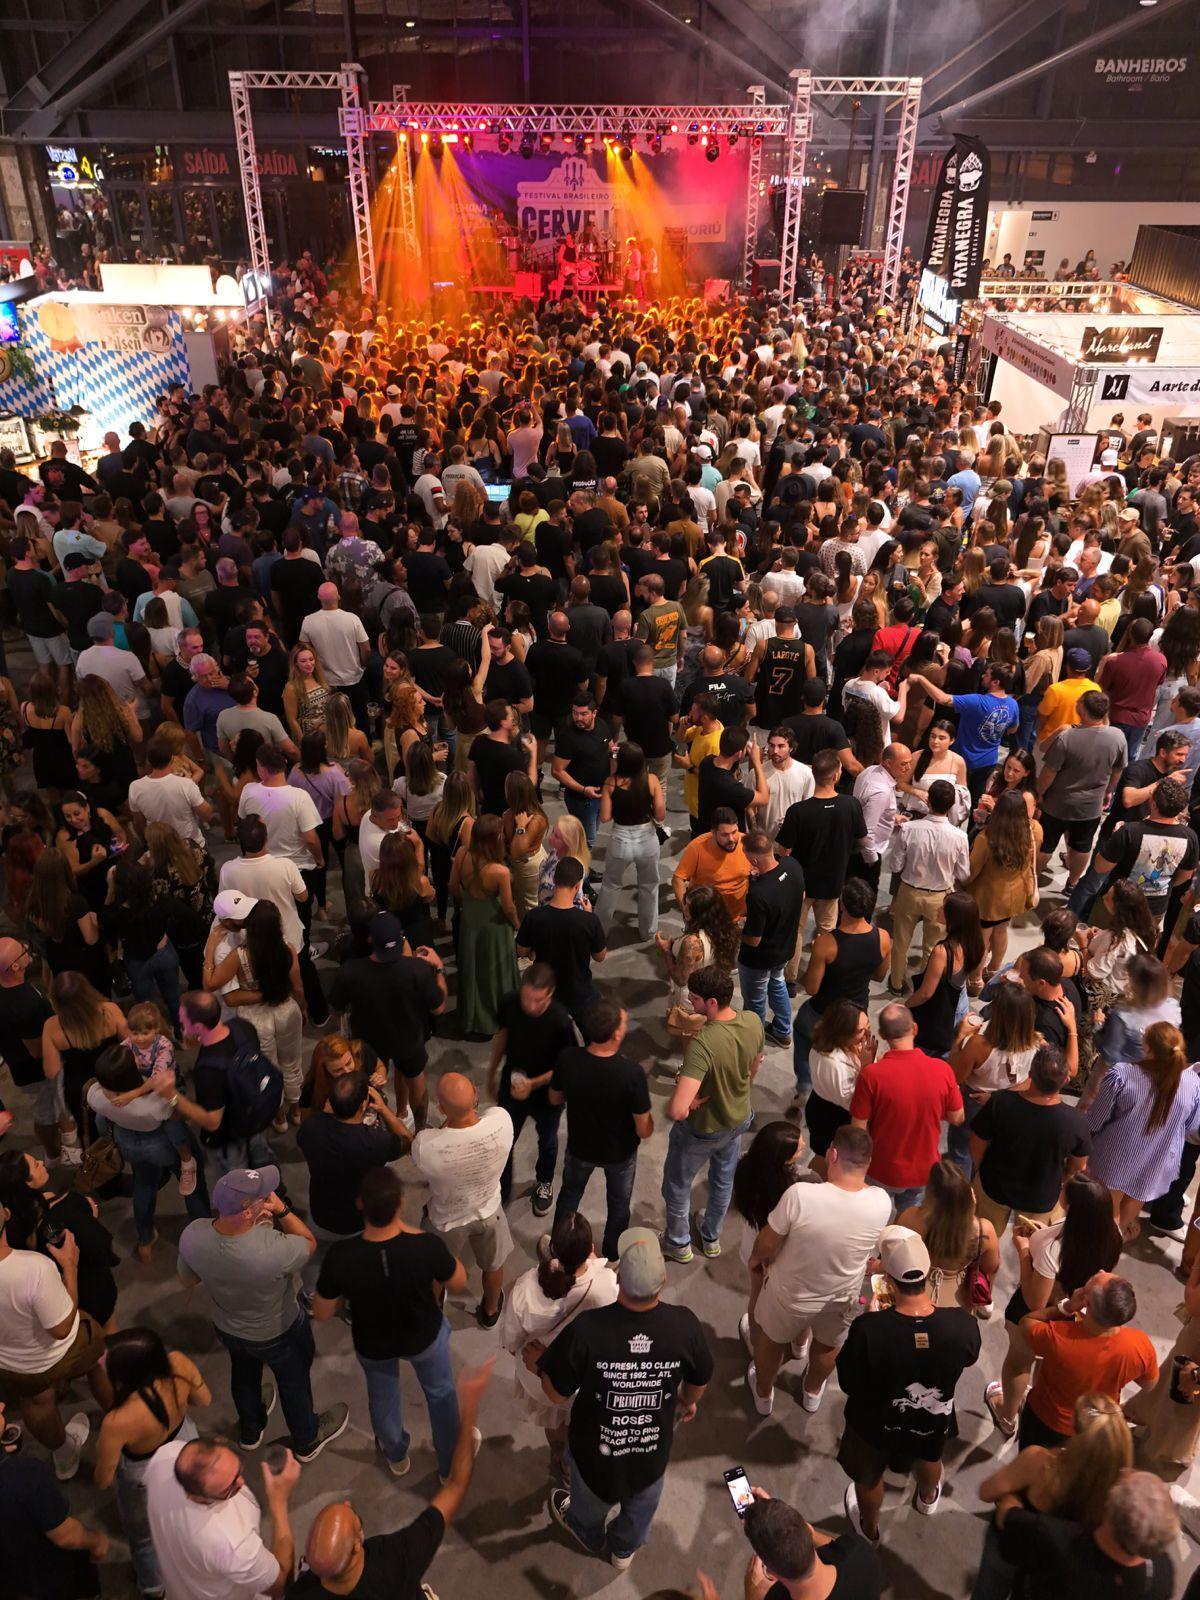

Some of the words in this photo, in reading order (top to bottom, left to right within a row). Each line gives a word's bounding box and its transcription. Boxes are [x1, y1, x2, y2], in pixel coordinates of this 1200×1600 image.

[1094, 58, 1187, 73] BANHEIROS
[1106, 74, 1143, 83] Bathroom
[184, 148, 230, 175] SAÍDA
[255, 150, 298, 176] SAÍDA
[524, 192, 561, 200] FESTIVAL
[563, 192, 609, 200] BRASILEIRO
[928, 190, 955, 265] PATANEGRA
[951, 197, 975, 288] PATANEGRA
[1149, 380, 1160, 392] A
[1162, 382, 1188, 392] arte
[708, 682, 727, 691] FILA
[769, 666, 794, 695] 7
[596, 1361, 608, 1370] SO
[610, 1361, 639, 1370] FRESH,
[641, 1361, 653, 1370] SO
[654, 1360, 681, 1370] CLEAN
[603, 1371, 628, 1380] SINCE
[629, 1371, 647, 1380] 1992
[658, 1370, 672, 1378] ATL
[612, 1379, 662, 1389] WORLDWIDE
[612, 1394, 658, 1408] PRIMITIVE
[612, 1414, 653, 1426] ROSES
[600, 1425, 628, 1437] TRYING
[630, 1428, 641, 1436] TO
[642, 1426, 660, 1435] FIND
[600, 1433, 626, 1446] PEACE
[640, 1433, 659, 1444] MIND
